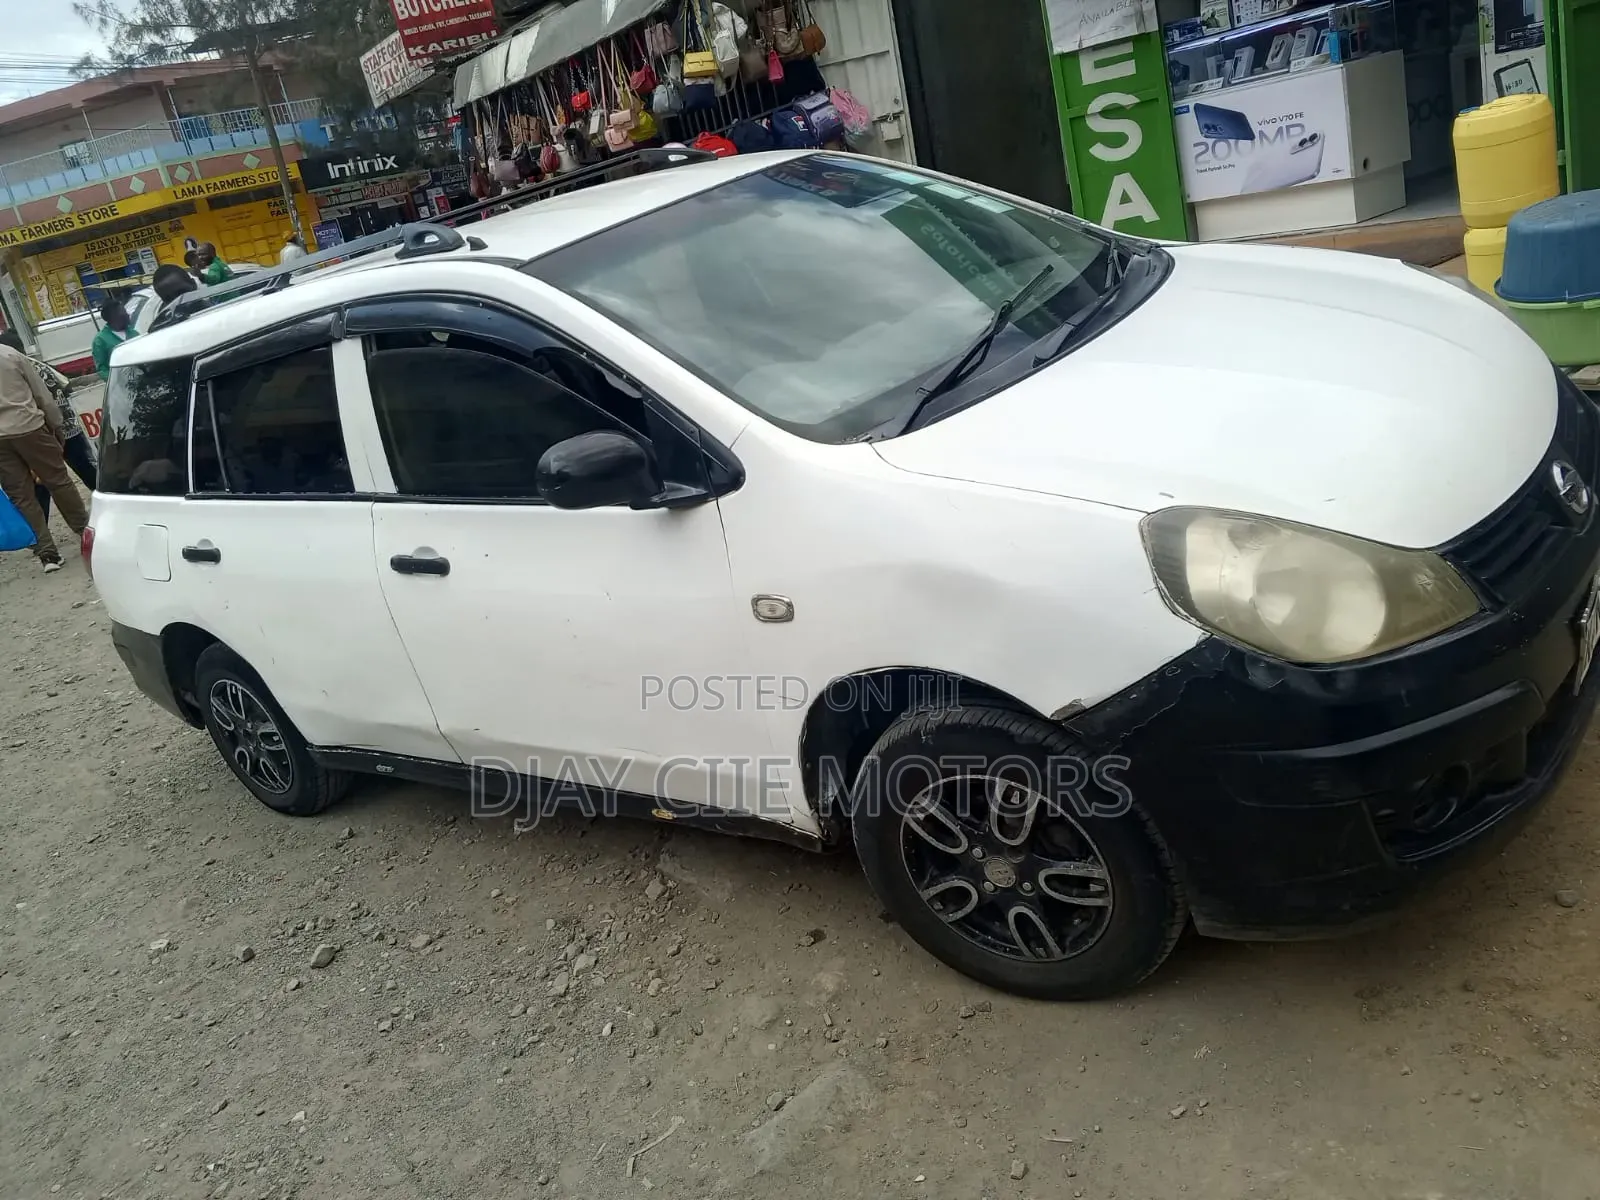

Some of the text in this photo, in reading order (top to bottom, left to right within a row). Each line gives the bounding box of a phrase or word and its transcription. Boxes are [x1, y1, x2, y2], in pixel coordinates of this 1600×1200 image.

[173, 167, 293, 200] LAMA FARMERS STOE
[20, 216, 75, 241] FARMERS
[77, 205, 120, 225] STORE
[85, 225, 161, 252] ISINYA FEEDS
